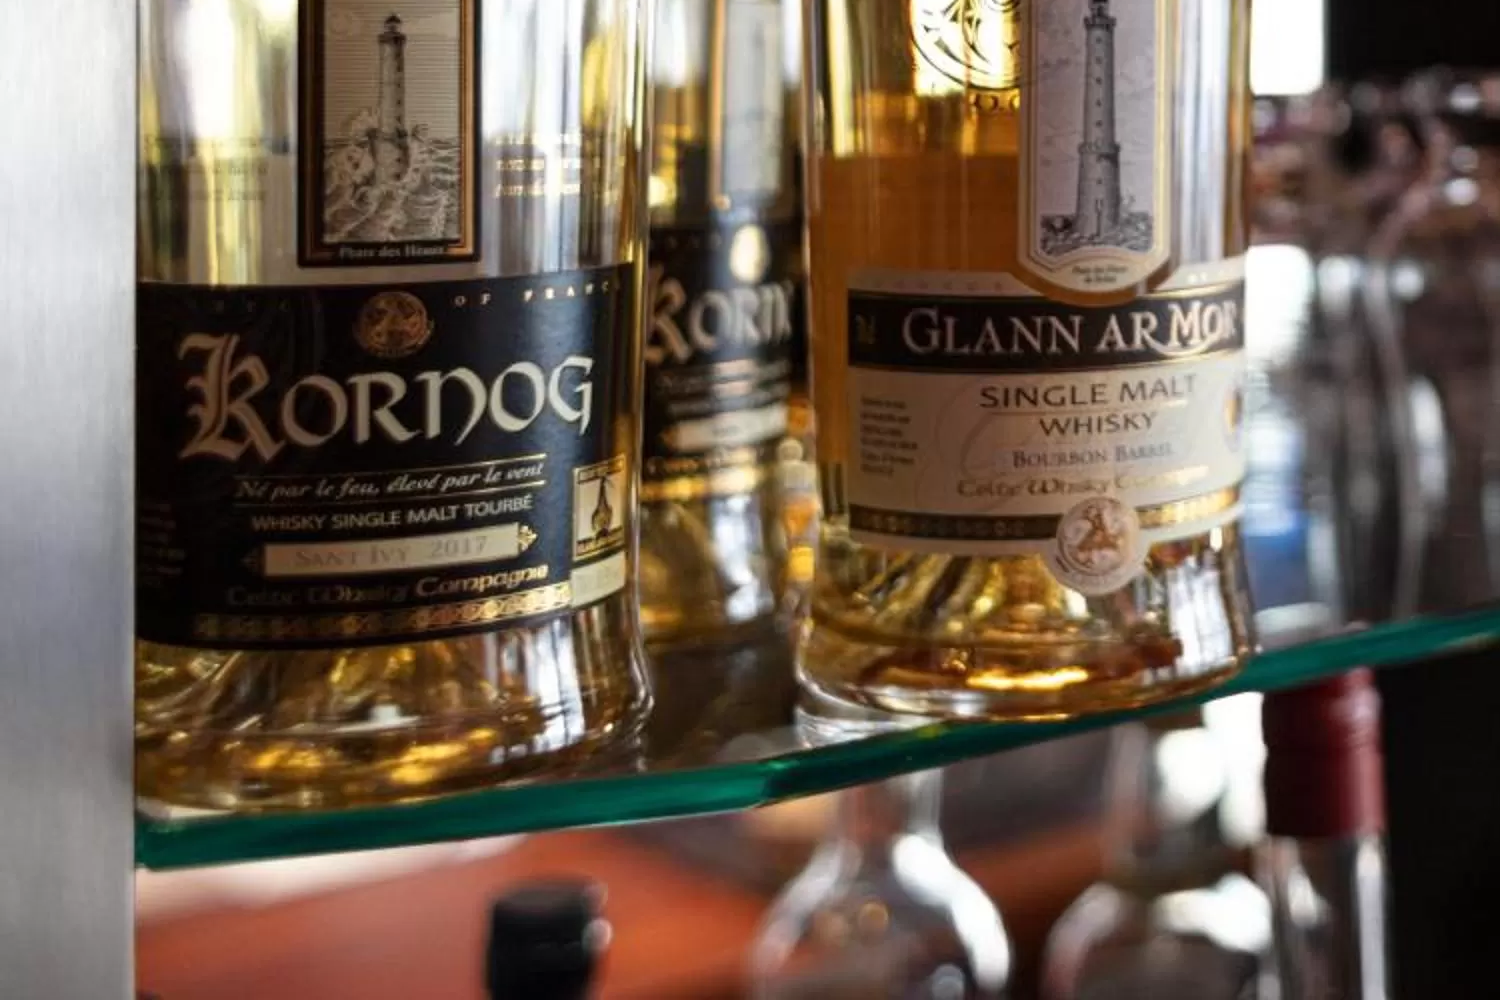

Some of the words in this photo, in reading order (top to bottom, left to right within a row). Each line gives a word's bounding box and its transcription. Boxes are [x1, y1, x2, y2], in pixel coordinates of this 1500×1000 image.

[454, 292, 491, 306] OF
[901, 305, 1085, 356] GLANN
[979, 383, 1108, 409] SINGLE
[1118, 373, 1197, 403] MALT
[1038, 411, 1157, 437] WHISKY
[1012, 449, 1108, 469] BOURBON
[271, 484, 313, 501] par
[315, 478, 335, 497] le
[440, 473, 482, 493] par
[482, 464, 502, 484] le
[505, 462, 545, 479] vent
[251, 514, 328, 532] WHISKY
[330, 509, 401, 530] SINGLE
[406, 505, 461, 524] MALT
[463, 494, 535, 519] TOURBÉ
[430, 536, 488, 558] 2017
